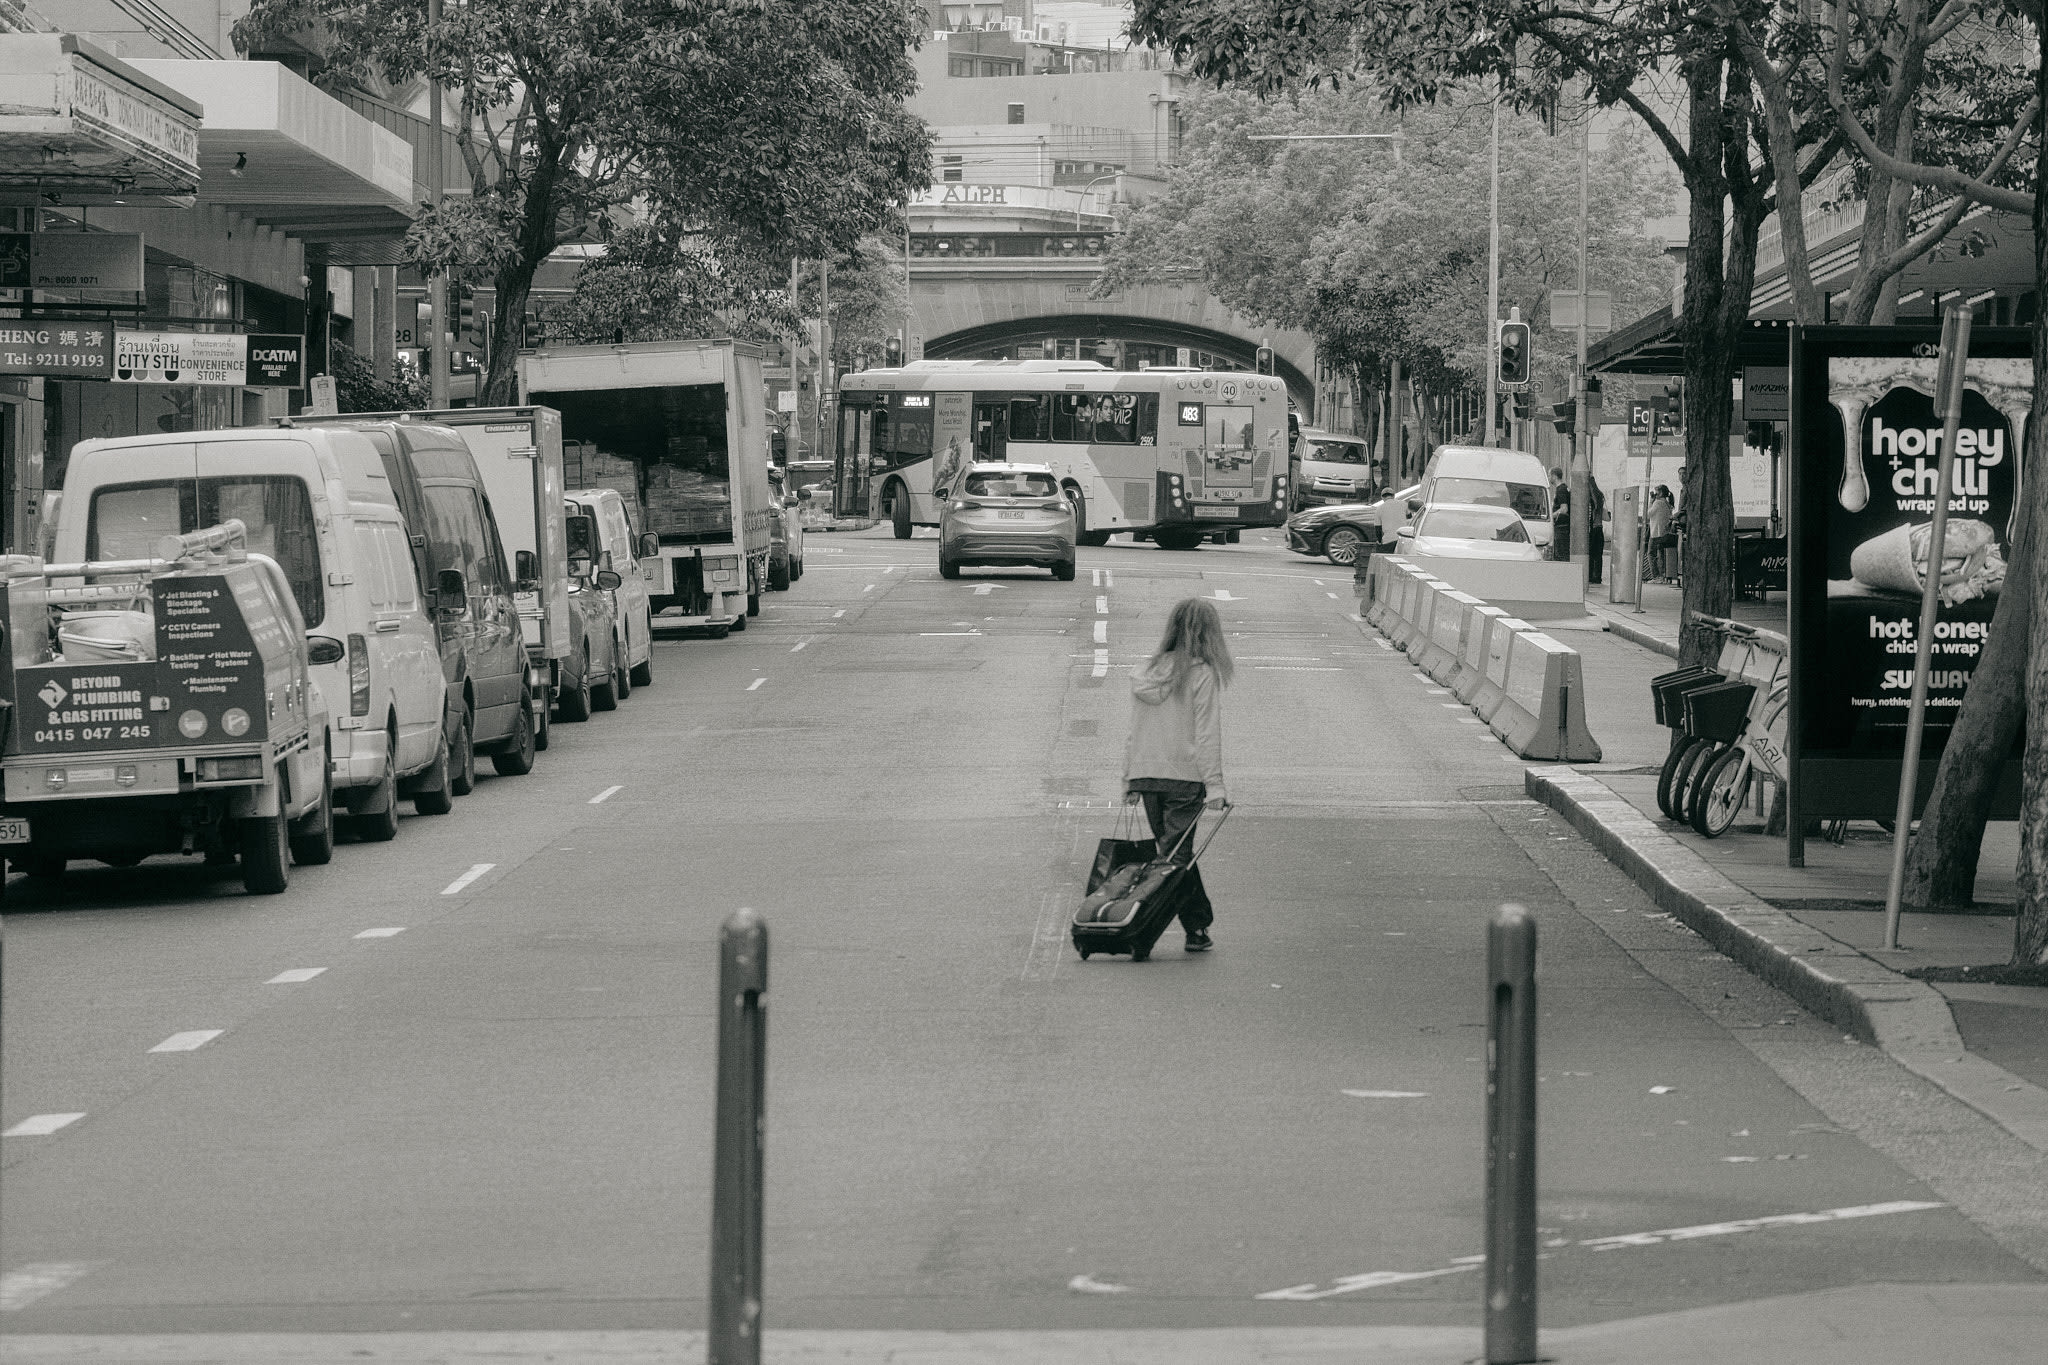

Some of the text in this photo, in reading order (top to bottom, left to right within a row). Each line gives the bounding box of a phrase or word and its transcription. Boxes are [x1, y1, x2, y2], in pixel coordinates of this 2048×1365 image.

[4, 352, 104, 367] Tel: 9211 9193
[119, 353, 179, 369] CITY STH
[252, 349, 297, 362] DCATM
[180, 359, 245, 371] CONVENIENCE
[261, 363, 287, 371] AVAILABLE
[197, 370, 227, 381] STORE
[1222, 386, 1236, 396] 40
[1633, 406, 1649, 424] Fo
[1872, 417, 2004, 466] honey
[1892, 457, 1989, 495] chlli
[1896, 496, 1990, 514] wraped up
[166, 589, 219, 599] Jet Blasting &
[167, 607, 210, 616] Specialists
[168, 623, 190, 631] CCTV
[1869, 615, 1992, 644] hot oney
[168, 631, 214, 640] Inspections
[1885, 639, 1980, 657] chicn wrap
[170, 653, 206, 661] Backflow
[170, 662, 199, 670] Testing
[215, 660, 249, 668] Systems
[71, 676, 121, 690] BEYOND
[189, 676, 238, 685] Maintenance
[1880, 670, 1974, 690] SUWAY
[189, 685, 227, 693] Plumbing
[72, 690, 142, 705] PLUMBING
[1851, 697, 1877, 708] hurry,
[1878, 697, 1912, 708] nothing
[1931, 697, 1962, 707] delicio
[48, 708, 143, 724] & GAS FITTING
[35, 726, 151, 742] 0415 047 245
